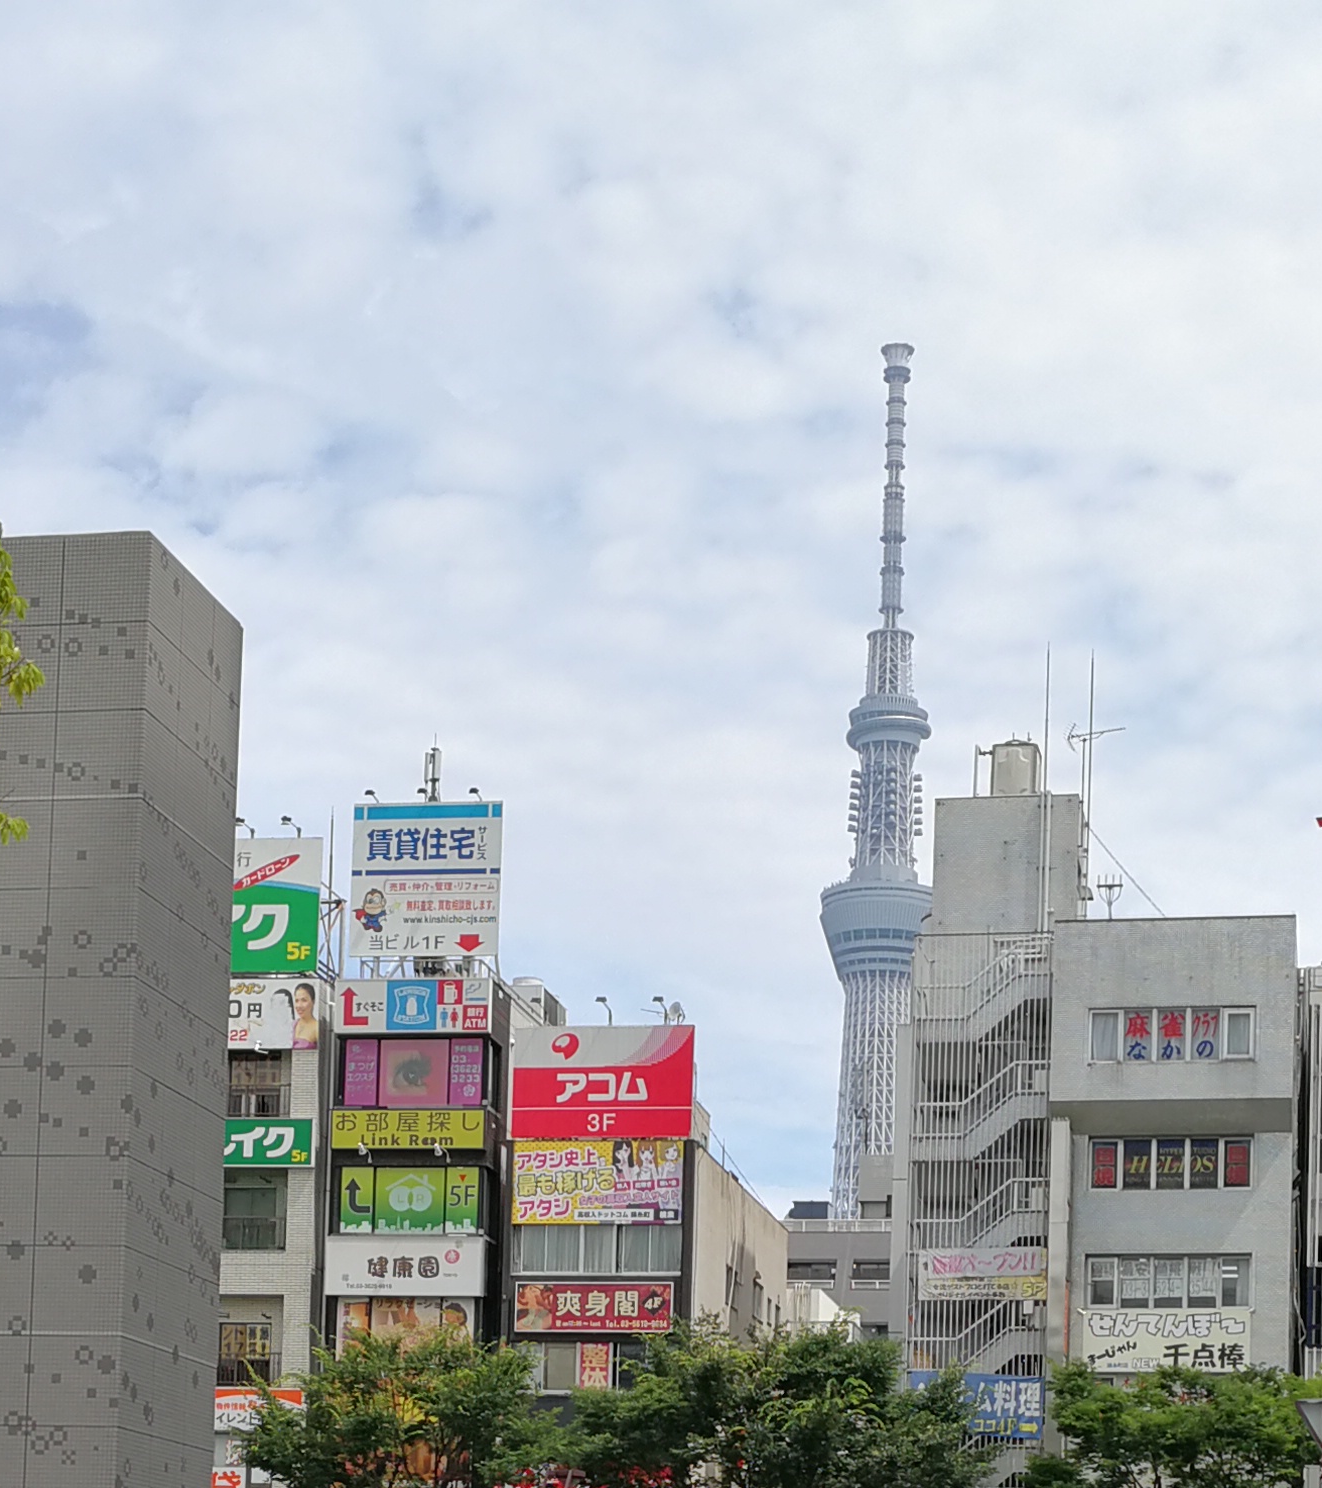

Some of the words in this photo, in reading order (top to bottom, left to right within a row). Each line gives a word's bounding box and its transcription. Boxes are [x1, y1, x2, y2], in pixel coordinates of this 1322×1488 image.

[367, 827, 475, 861] 賃貸住宅
[477, 826, 488, 860] サービス
[237, 852, 252, 867] 行
[241, 858, 291, 887] カードローン
[403, 914, 497, 925] www.kinshicho-cjs.com
[286, 942, 311, 960] 5F
[369, 933, 446, 950] 当ビル1F
[356, 1001, 384, 1012] すぐそこ
[464, 1018, 487, 1029] ATM
[1127, 1040, 1214, 1059] なかの
[556, 1072, 649, 1103] アコム
[335, 1112, 480, 1133] お部屋探し
[586, 1113, 617, 1132] 3F
[361, 1134, 401, 1146] Link
[291, 1151, 309, 1163] 5F
[517, 1149, 598, 1171] アタシ史上
[518, 1169, 617, 1198] 最も稼げる
[449, 1185, 476, 1207] 5F
[518, 1199, 571, 1219] アタシ
[367, 1256, 440, 1279] 健康園
[555, 1290, 639, 1317] 爽身閣
[581, 1343, 609, 1389] 整体
[1132, 1358, 1160, 1369] NEW
[1163, 1343, 1246, 1369] 千点棒
